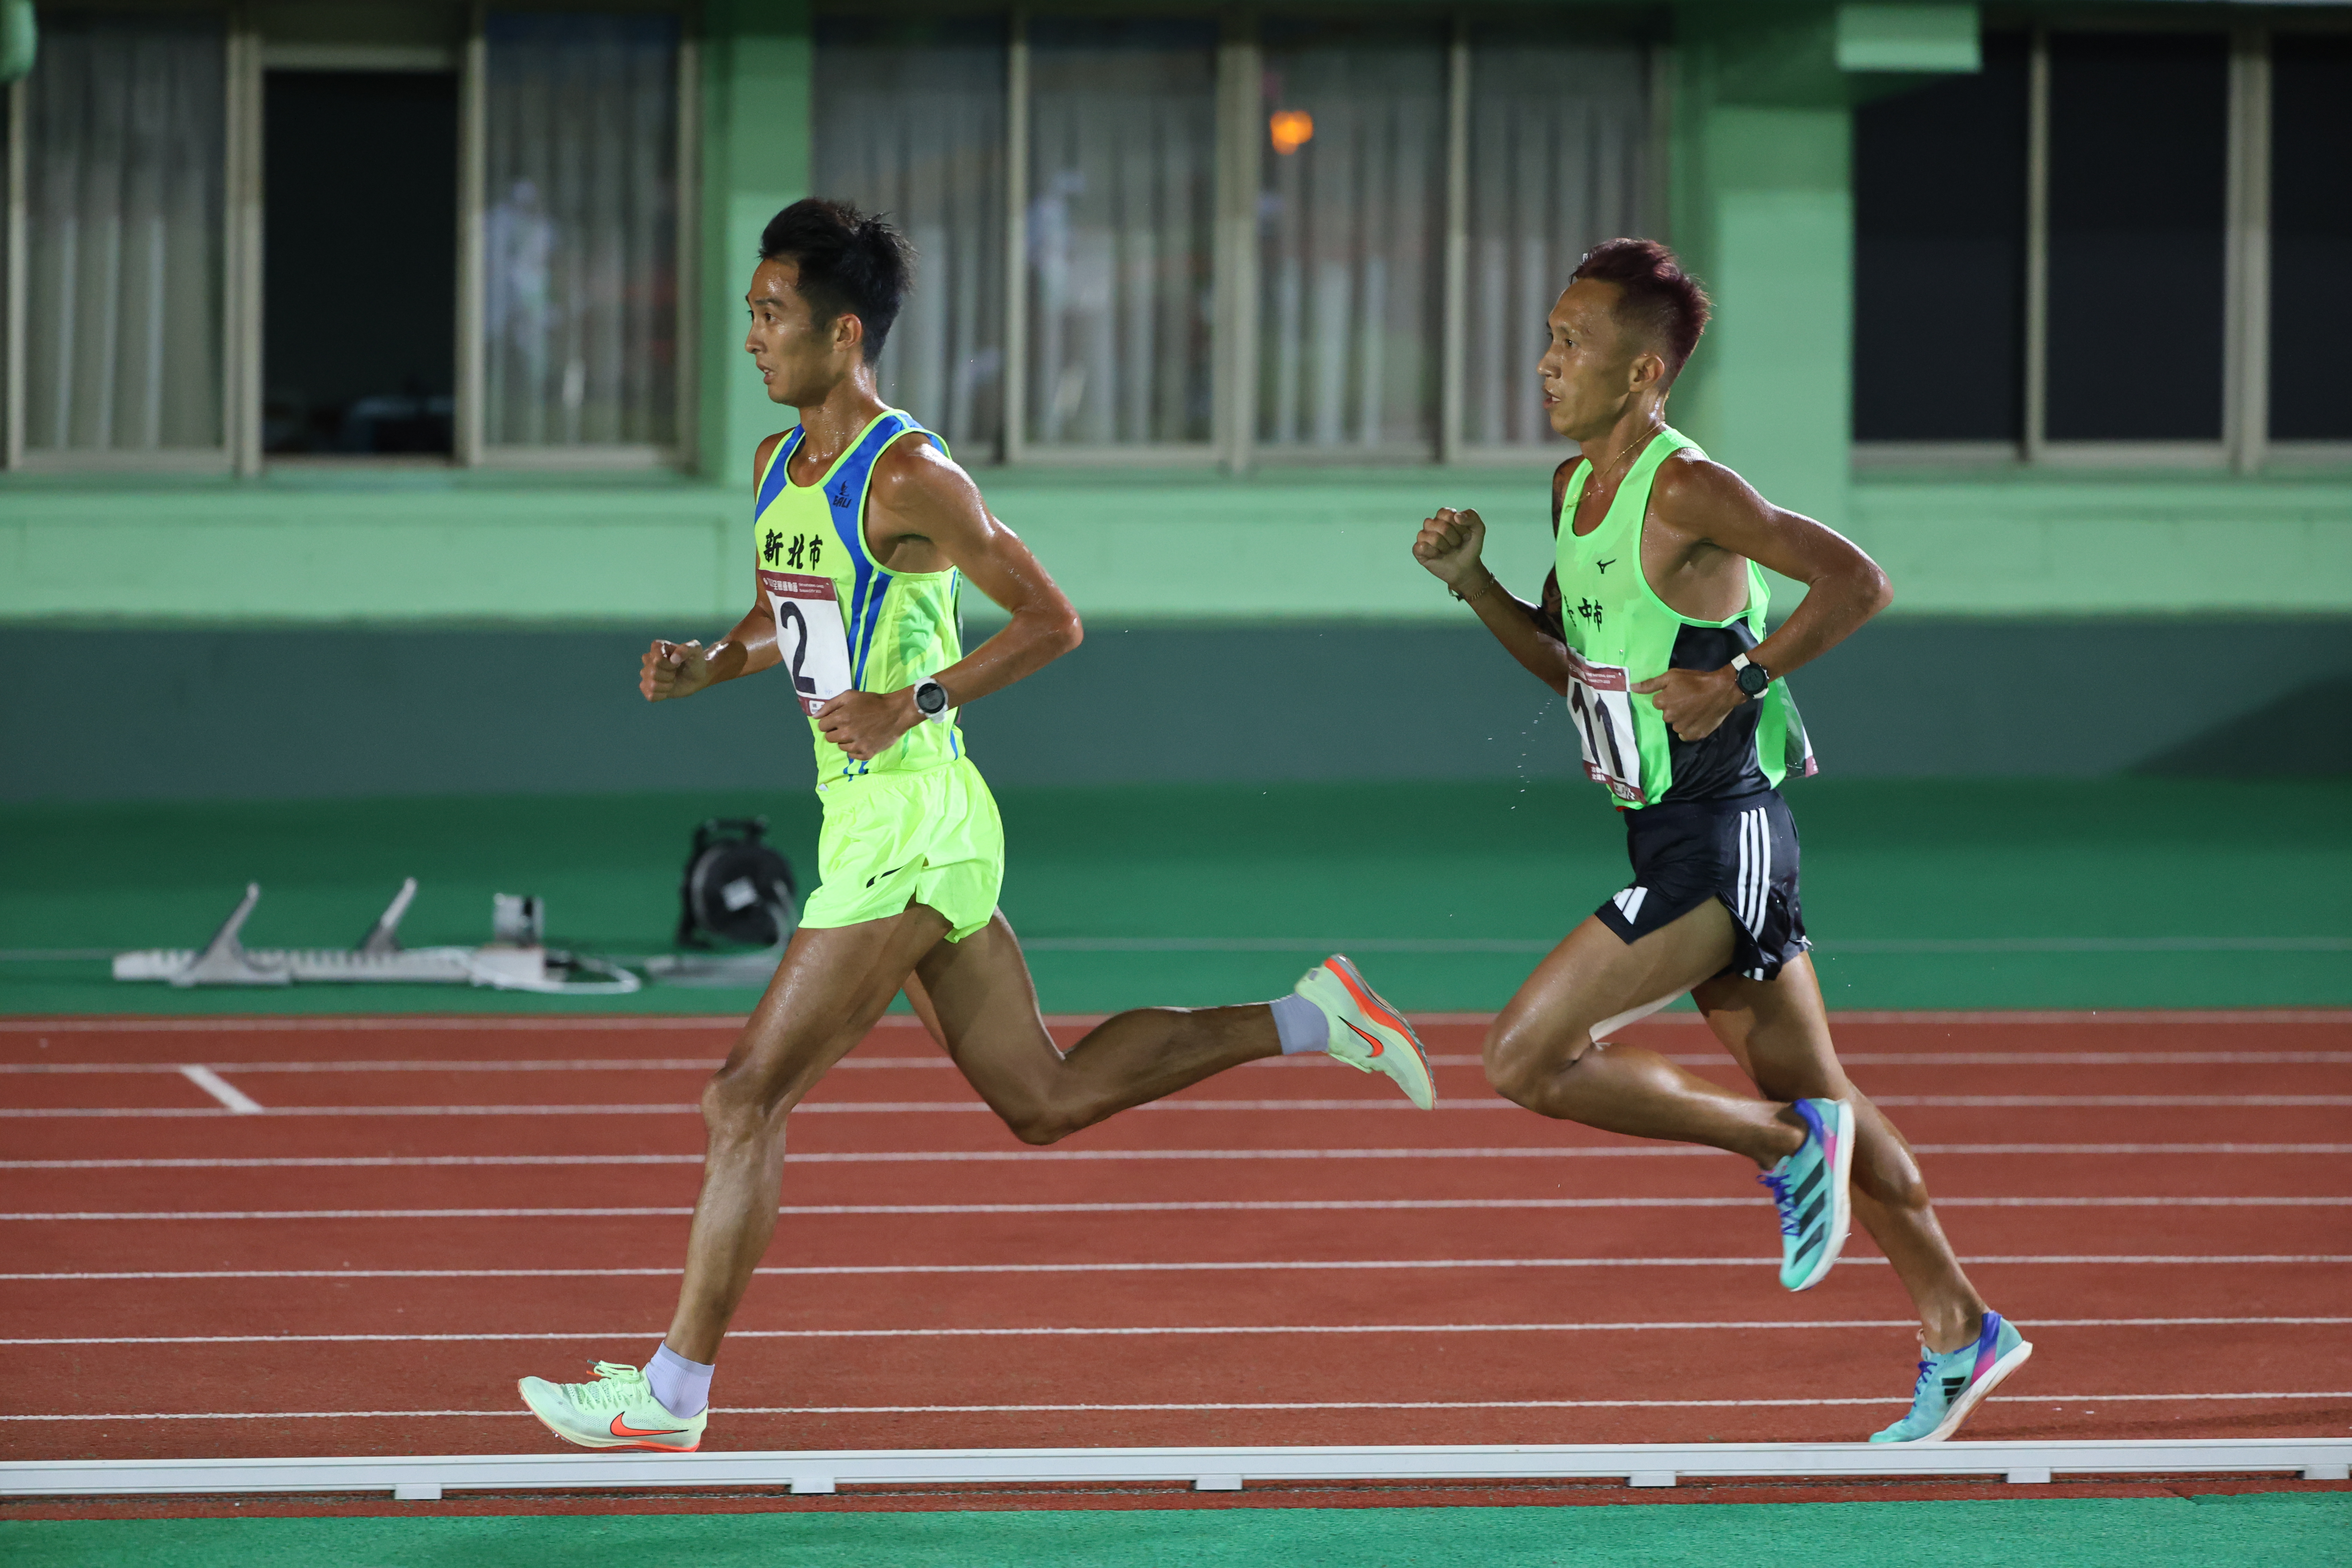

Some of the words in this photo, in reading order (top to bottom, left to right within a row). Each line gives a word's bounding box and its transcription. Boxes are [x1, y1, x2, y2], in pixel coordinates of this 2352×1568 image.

[764, 528, 822, 571] 新北市
[780, 601, 816, 694] 2
[1572, 681, 1625, 778] 11
